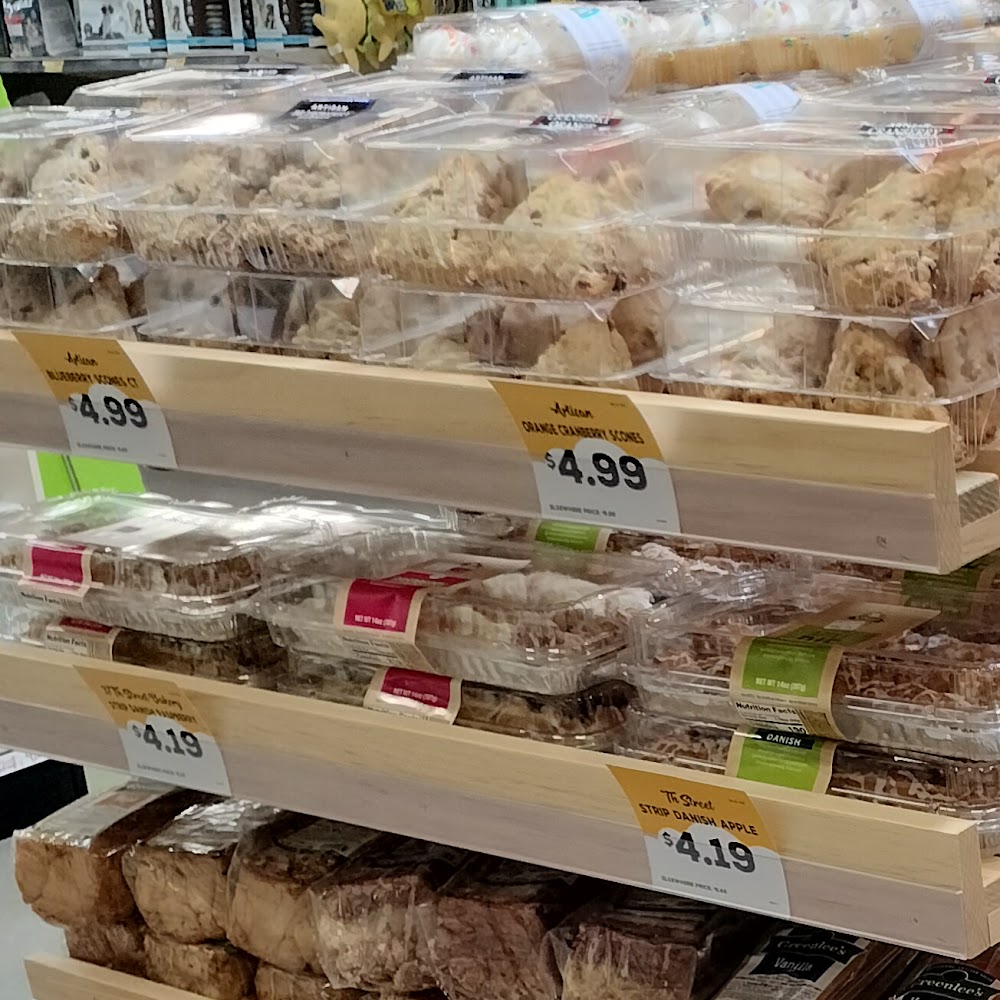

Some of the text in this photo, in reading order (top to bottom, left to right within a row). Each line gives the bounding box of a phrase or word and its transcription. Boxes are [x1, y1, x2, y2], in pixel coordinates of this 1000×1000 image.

[46, 369, 94, 385] BLUEBERRY
[95, 374, 127, 387] SCONES
[68, 393, 149, 429] $4.99
[551, 402, 594, 420] Artisan
[522, 420, 645, 445] ORANGE CRANBERRY SCONES
[544, 449, 648, 491] $4.99
[736, 702, 797, 715] Nutrition Facts
[132, 724, 203, 758] $4.19
[766, 733, 802, 747] DANISH
[638, 803, 759, 836] STRIP DANISH APPLE
[662, 831, 756, 873] $4.19
[774, 956, 814, 972] Vanilla
[917, 977, 985, 998] reenlee's
